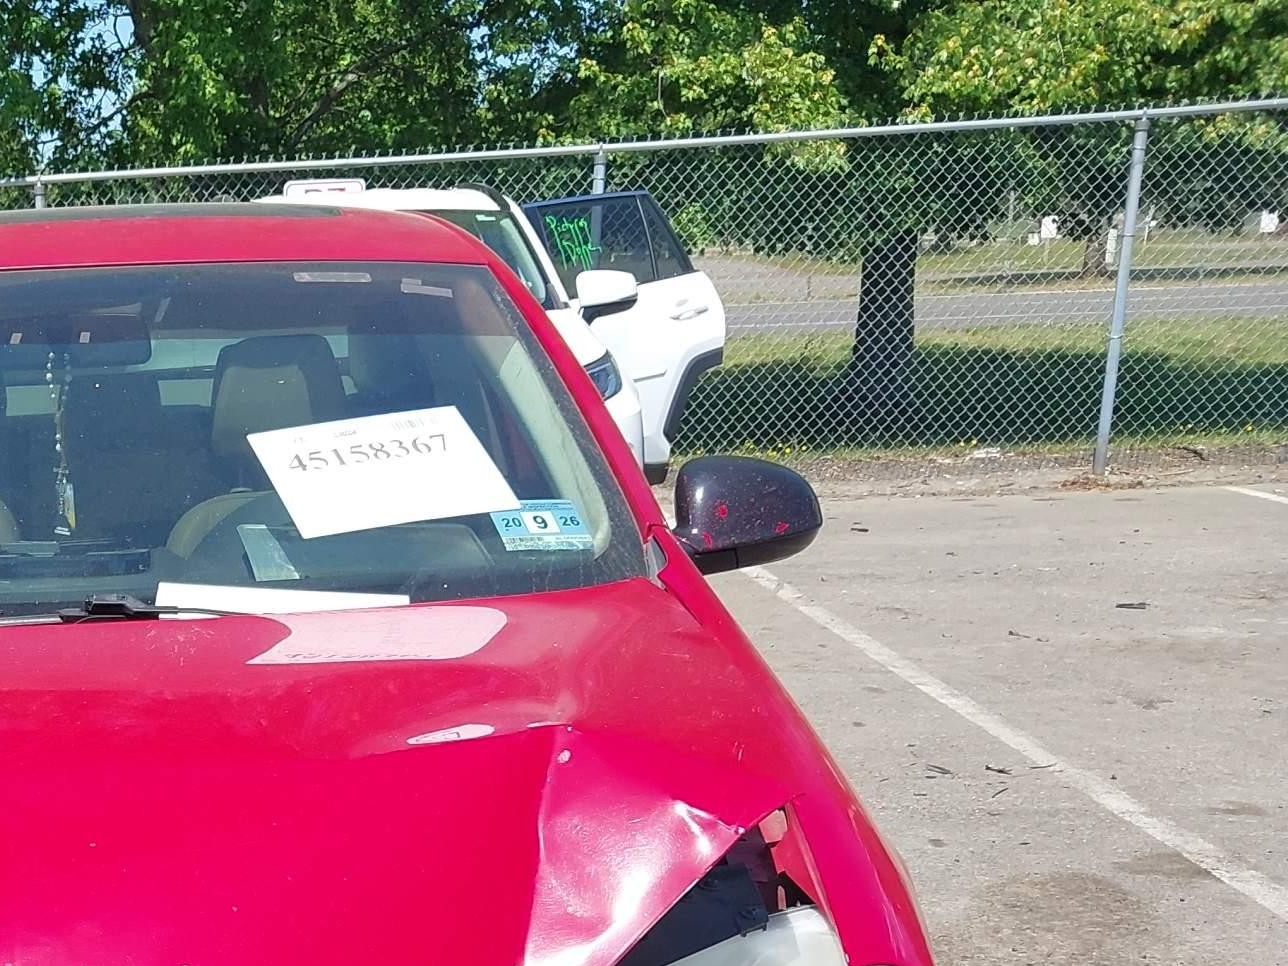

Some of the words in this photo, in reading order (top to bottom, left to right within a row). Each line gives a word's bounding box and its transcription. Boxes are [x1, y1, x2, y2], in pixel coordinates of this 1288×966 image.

[288, 433, 447, 471] 45158367
[501, 517, 522, 528] 20
[532, 515, 548, 529] 9
[559, 516, 580, 526] 26
